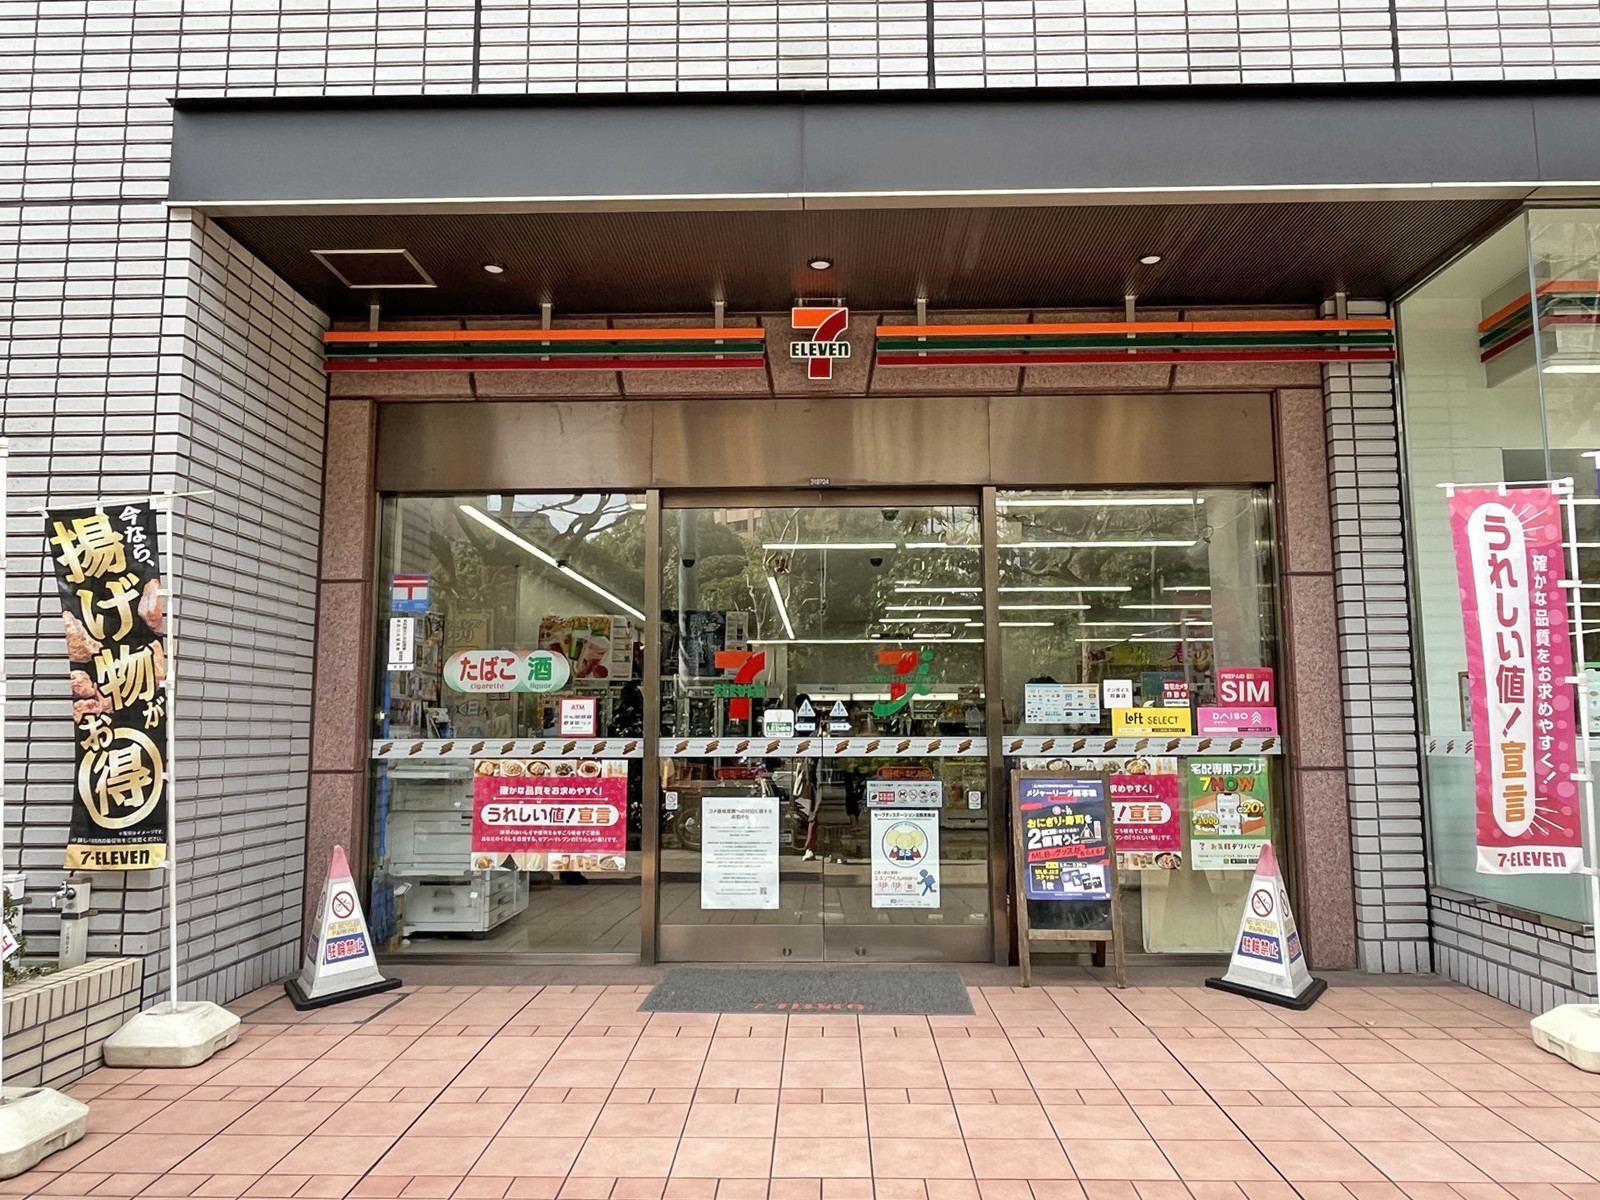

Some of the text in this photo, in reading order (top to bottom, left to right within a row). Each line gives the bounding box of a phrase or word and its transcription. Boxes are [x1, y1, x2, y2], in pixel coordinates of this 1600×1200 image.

[119, 506, 155, 567] 今なら、
[459, 656, 553, 681] たばこ 酒
[470, 682, 553, 691] cigarette liquor
[1220, 680, 1270, 702] SIM
[1125, 712, 1179, 725] Loft SELECT
[1212, 712, 1249, 720] DAISO
[1190, 763, 1262, 776] 宅配専用アプリ
[326, 937, 365, 961] 駐輪禁止
[1241, 935, 1279, 960] 駐輪禁止
